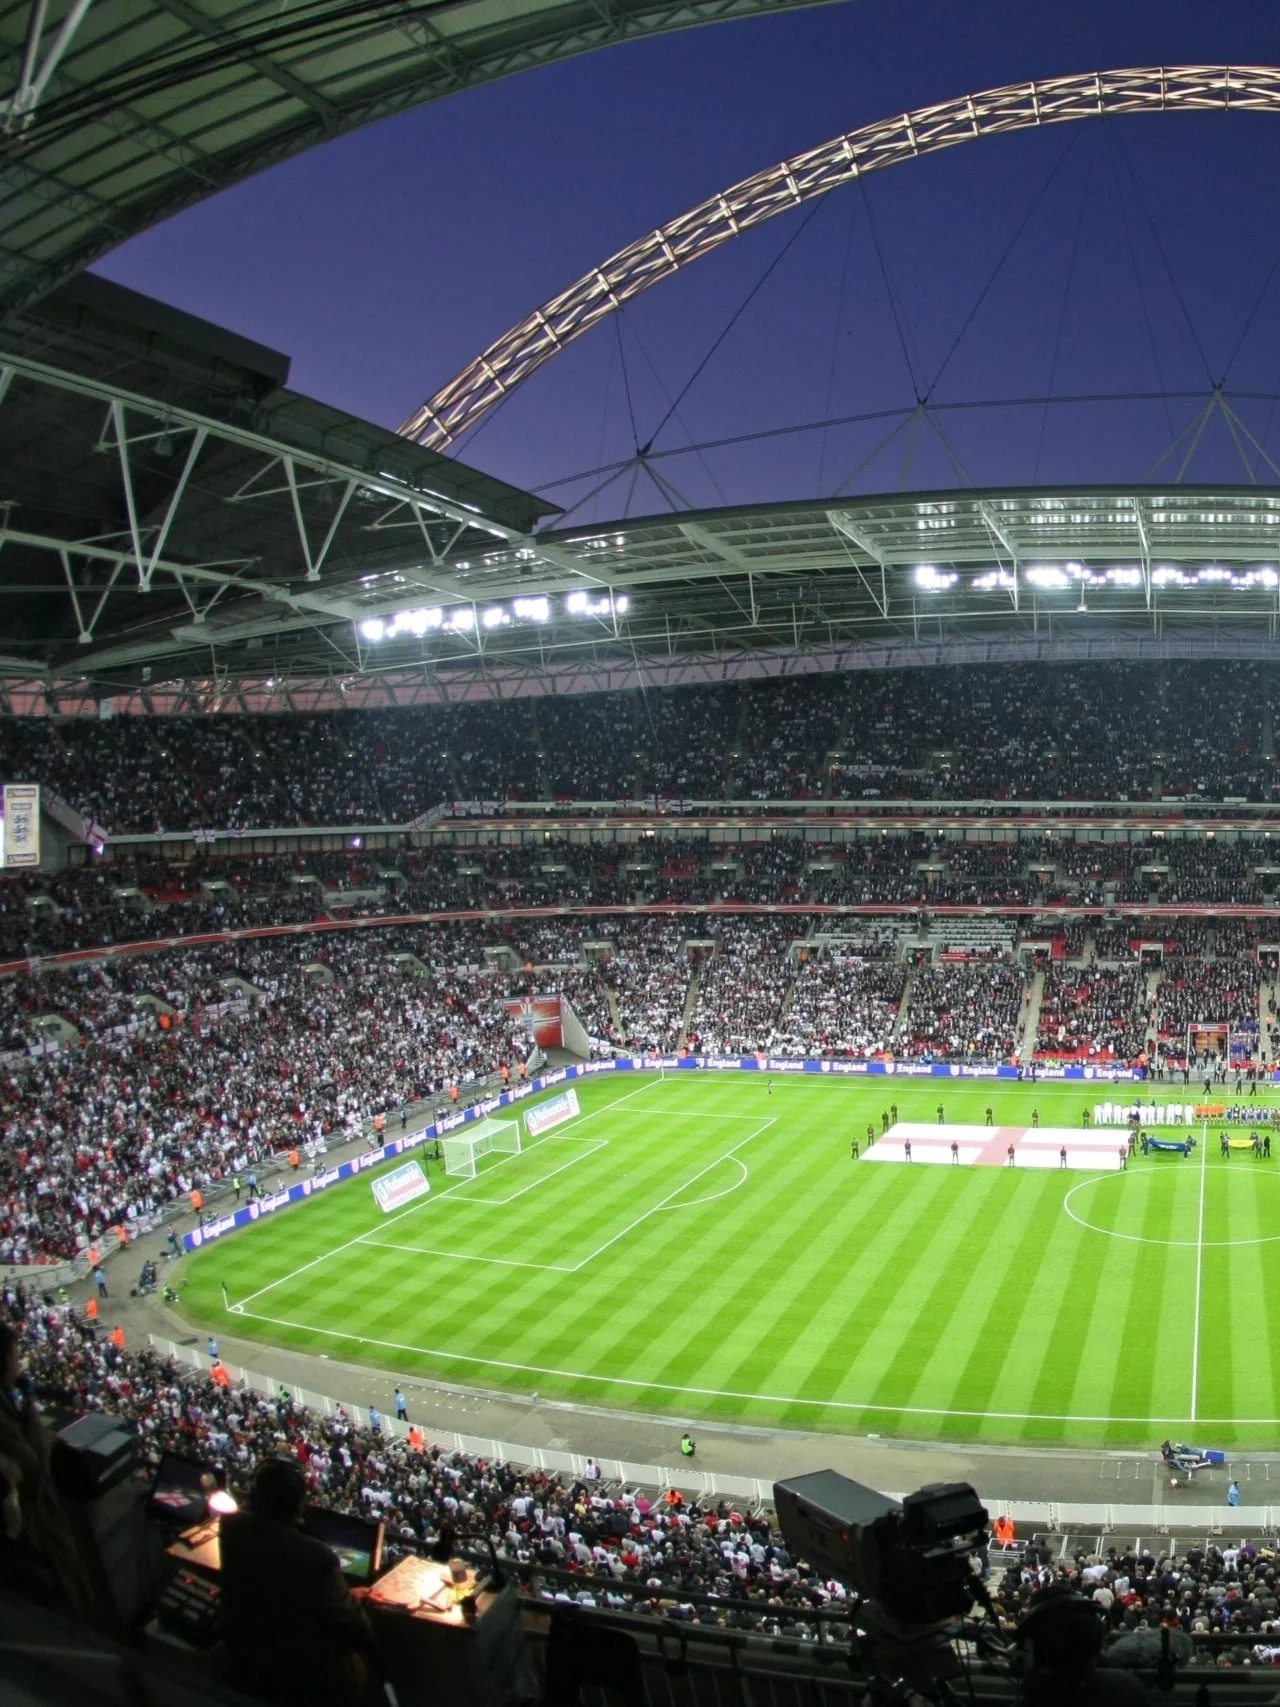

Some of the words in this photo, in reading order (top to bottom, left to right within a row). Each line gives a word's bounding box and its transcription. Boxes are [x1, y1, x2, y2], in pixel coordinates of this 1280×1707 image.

[585, 1060, 615, 1073] England
[708, 1059, 741, 1069] England
[770, 1060, 804, 1070] England
[833, 1062, 867, 1072] England
[897, 1064, 931, 1074] England
[963, 1066, 997, 1076] England
[443, 1112, 465, 1130] England
[403, 1129, 427, 1148] England
[360, 1148, 385, 1167] England
[312, 1168, 339, 1188] England
[260, 1190, 290, 1212] England
[202, 1215, 235, 1237] England
